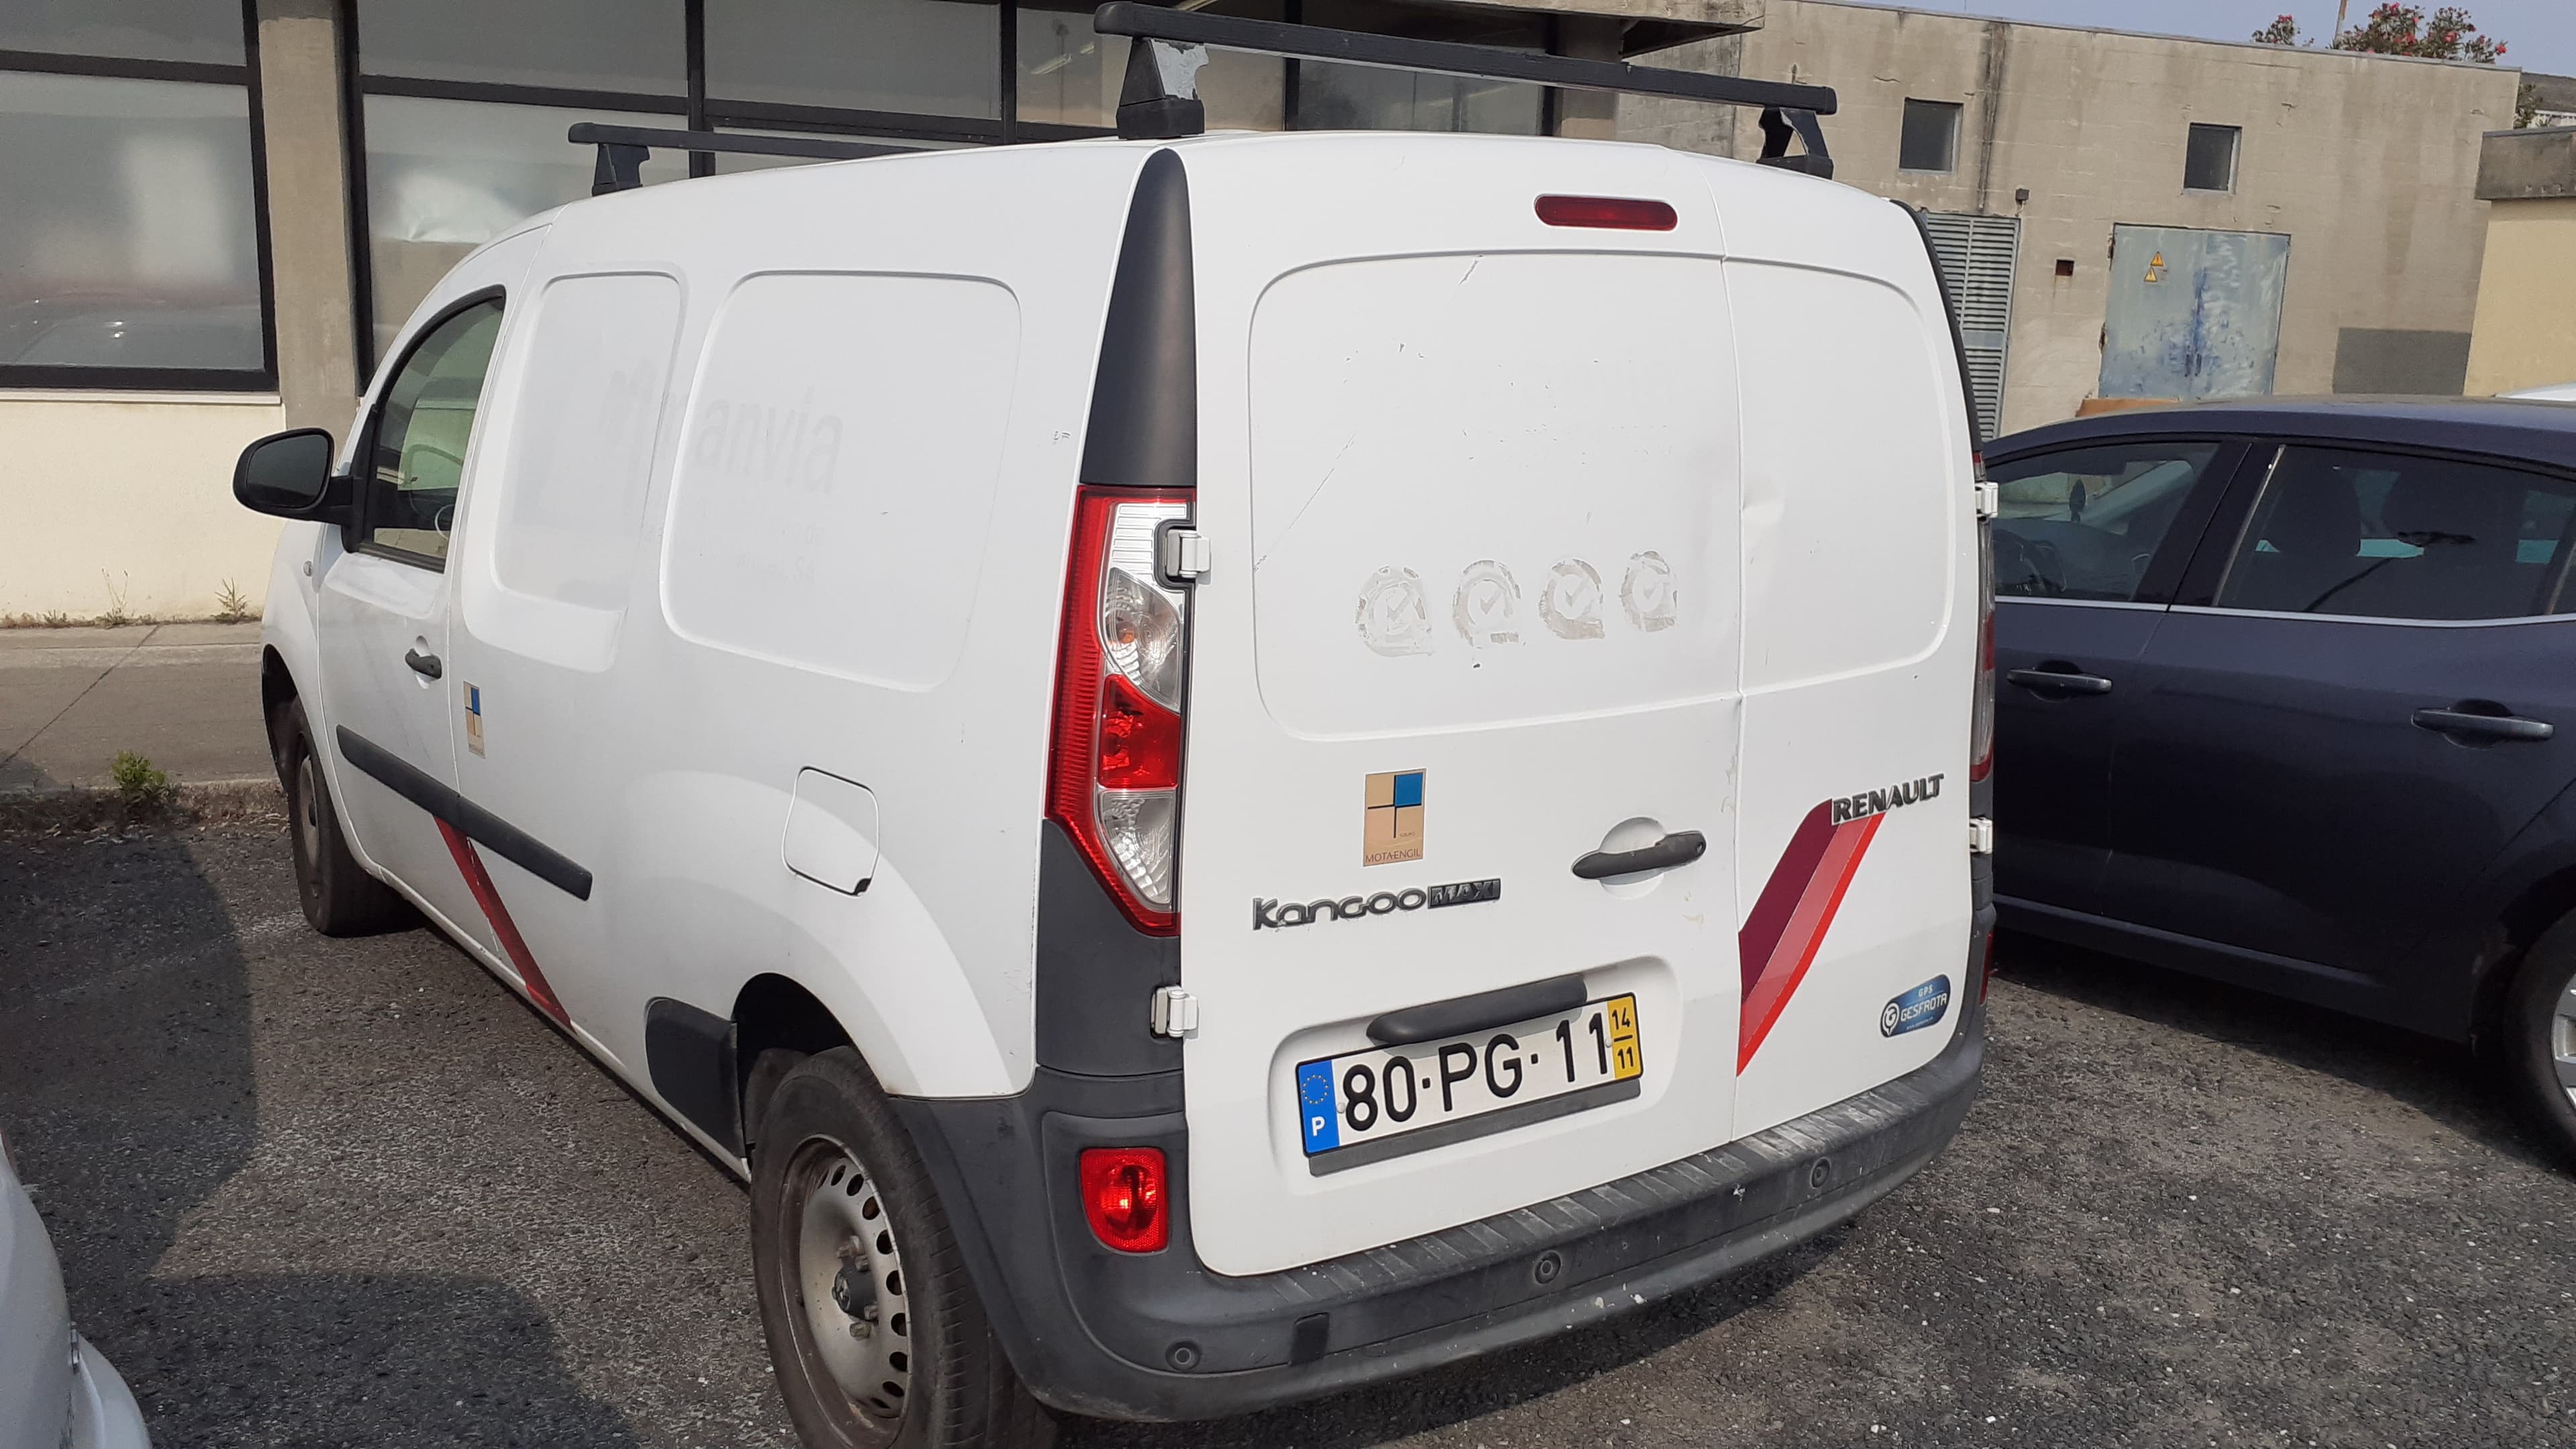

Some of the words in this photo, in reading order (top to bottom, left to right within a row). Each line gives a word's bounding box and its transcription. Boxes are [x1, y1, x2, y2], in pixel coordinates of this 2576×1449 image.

[1832, 772, 1944, 824] RENAULT
[1253, 888, 1427, 930] Kangoo
[1431, 879, 1500, 906] MAXI
[1918, 984, 1933, 998] GPS
[1611, 1007, 1631, 1030] 14
[1900, 993, 1947, 1022] GESFROTA
[1617, 1049, 1634, 1070] 11
[1311, 1116, 1326, 1136] P
